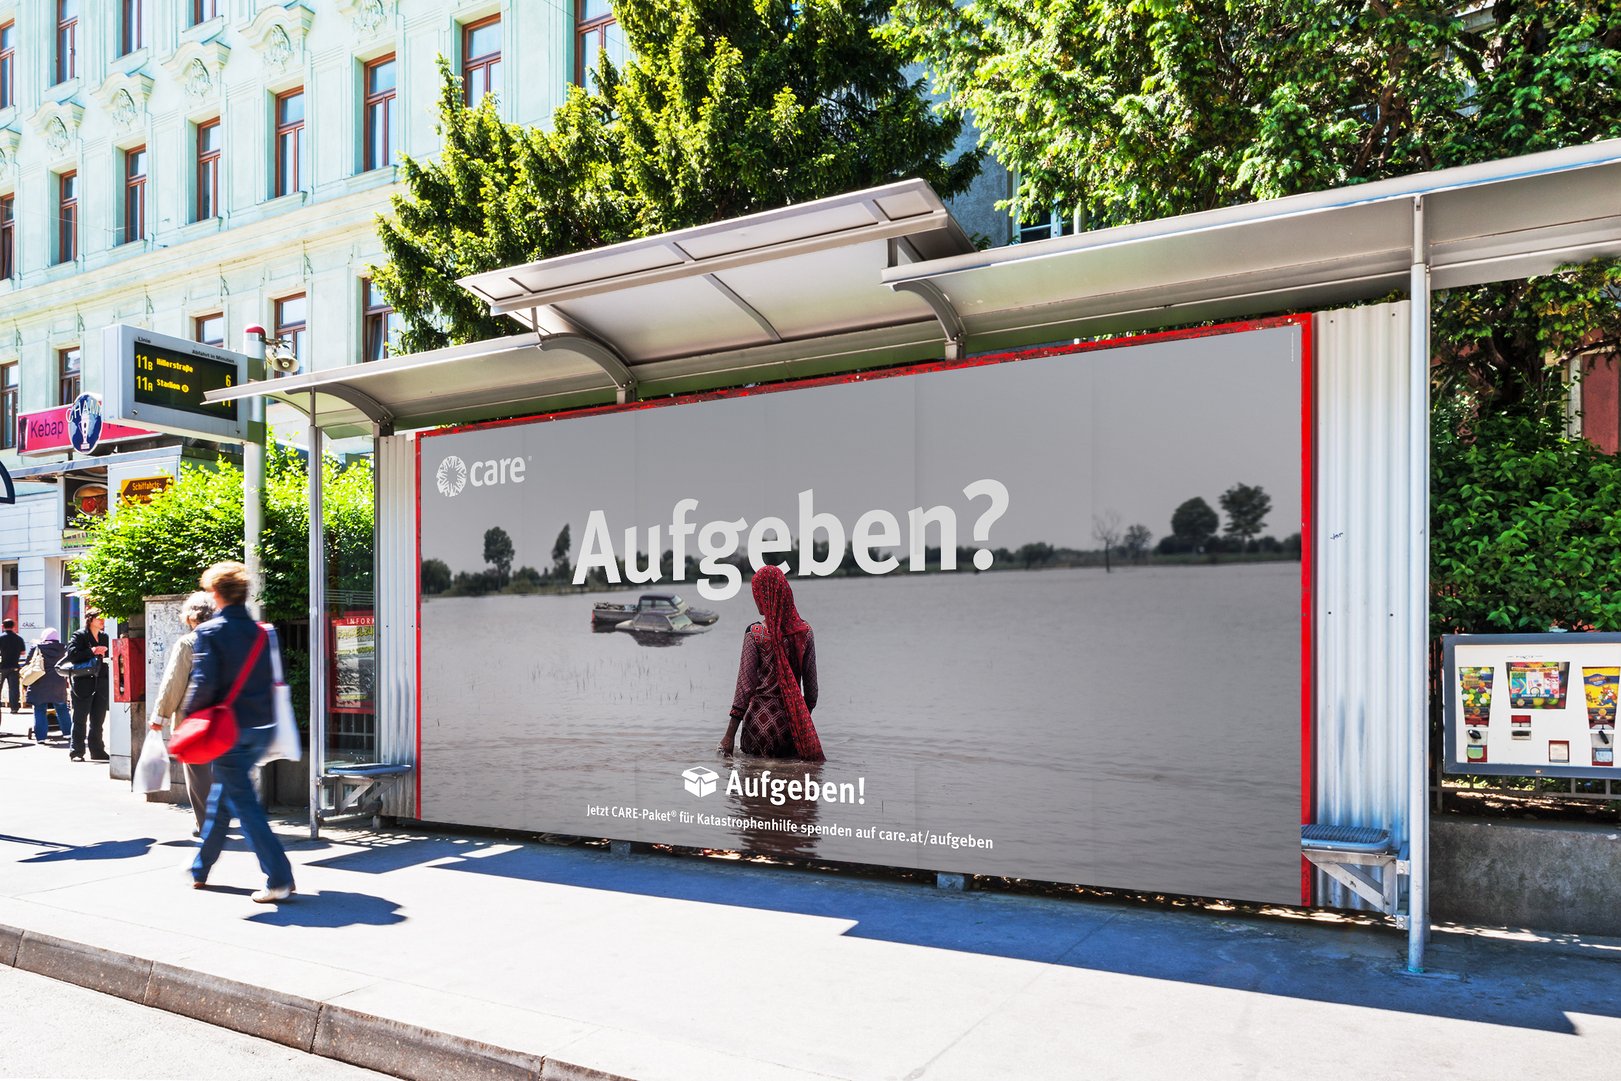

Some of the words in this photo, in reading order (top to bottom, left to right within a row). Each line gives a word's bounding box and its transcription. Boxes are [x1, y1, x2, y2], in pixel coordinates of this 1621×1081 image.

[136, 354, 153, 371] 11B
[225, 374, 232, 387] 6
[136, 375, 153, 392] 11A
[156, 378, 180, 391] Stadion
[30, 419, 64, 439] Kebap
[470, 457, 526, 487] care
[572, 479, 1010, 600] Aufgeben?
[726, 770, 866, 806] Aufgeben!
[587, 804, 610, 817] Jetzt
[679, 812, 694, 824] für
[697, 813, 798, 833] Katastrophenhilfe
[801, 823, 852, 838] spenden
[855, 826, 876, 839] auf
[879, 830, 993, 849] care.at/aufgeben
